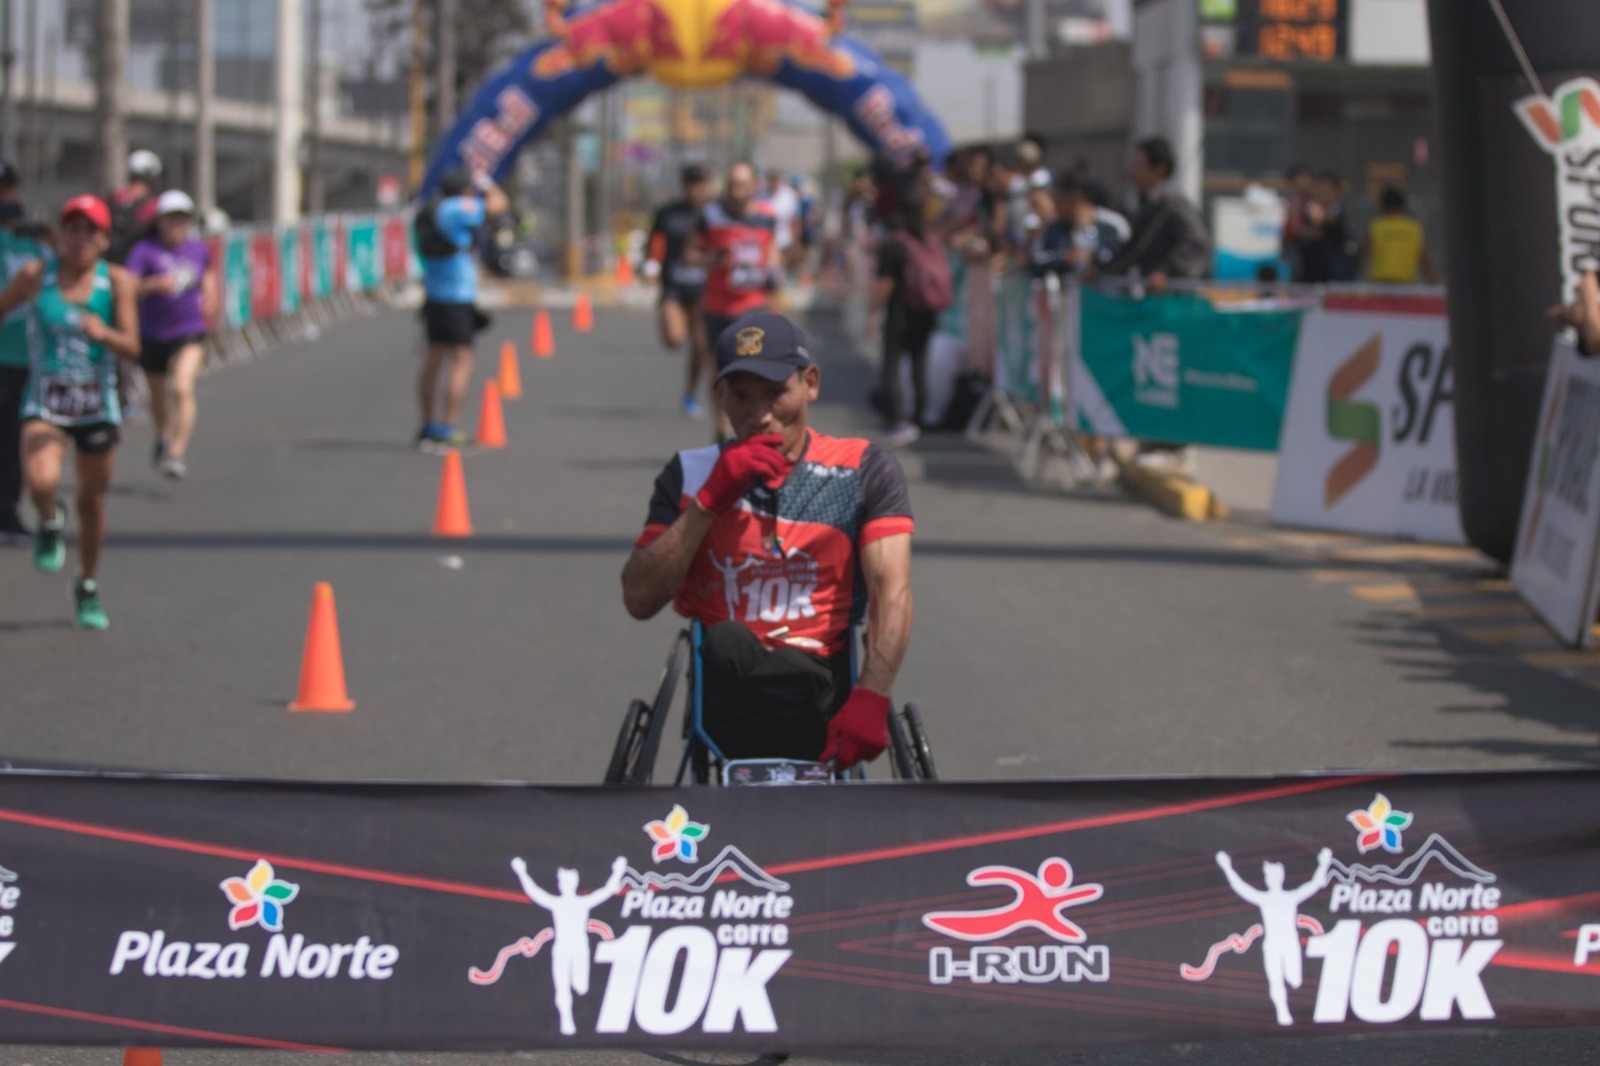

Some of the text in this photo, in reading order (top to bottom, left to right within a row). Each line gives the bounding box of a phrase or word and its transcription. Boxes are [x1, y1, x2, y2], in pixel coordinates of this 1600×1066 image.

[741, 576, 818, 622] 10K
[621, 888, 794, 920] Plaza Norte
[1330, 880, 1502, 914] Plaza Norte
[717, 923, 789, 946] corre
[1426, 914, 1499, 938] corre
[109, 930, 400, 980] Plaza Norte
[929, 944, 1110, 984] I-RUN
[1306, 918, 1504, 1024] 10K
[594, 925, 793, 1035] 10K
